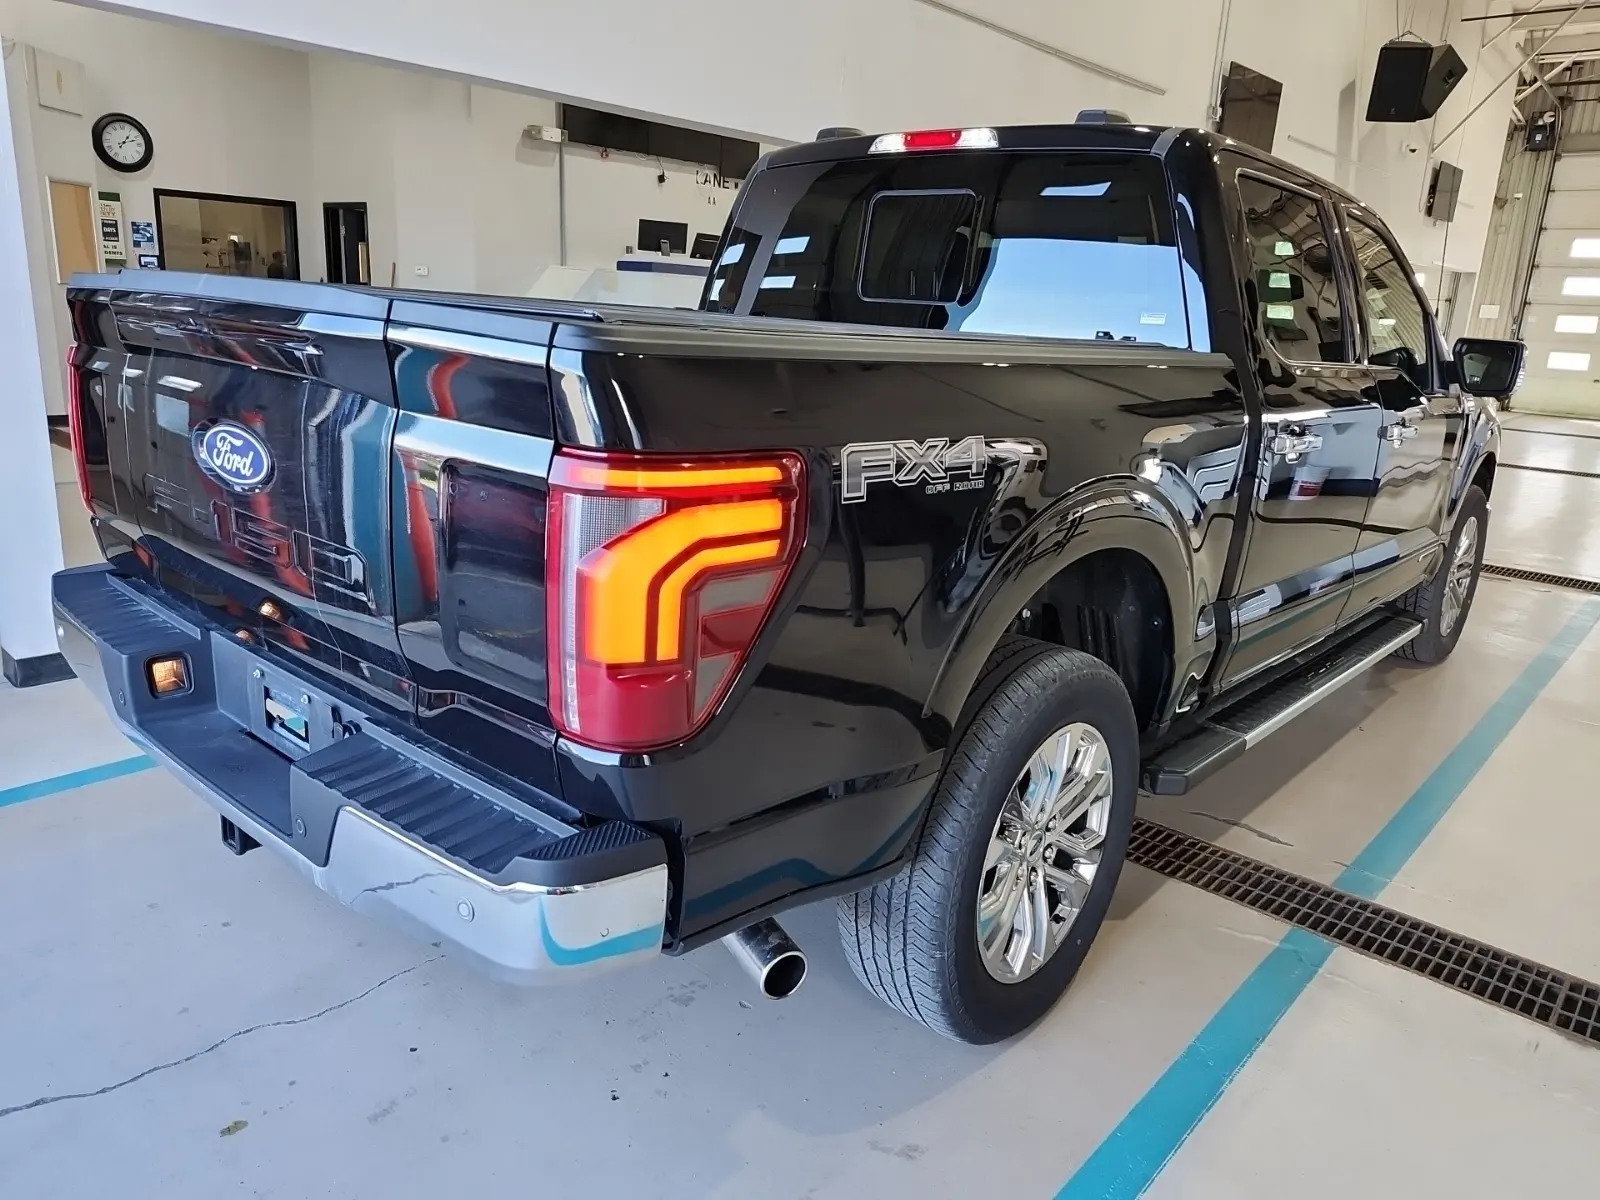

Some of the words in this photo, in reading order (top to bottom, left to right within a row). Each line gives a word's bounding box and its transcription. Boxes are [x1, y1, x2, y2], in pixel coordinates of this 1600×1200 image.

[696, 170, 729, 189] LANE
[213, 432, 254, 477] Ford
[841, 435, 987, 504] FX4
[926, 483, 951, 494] OFF
[953, 479, 985, 491] ROAD
[146, 472, 371, 606] F-150
